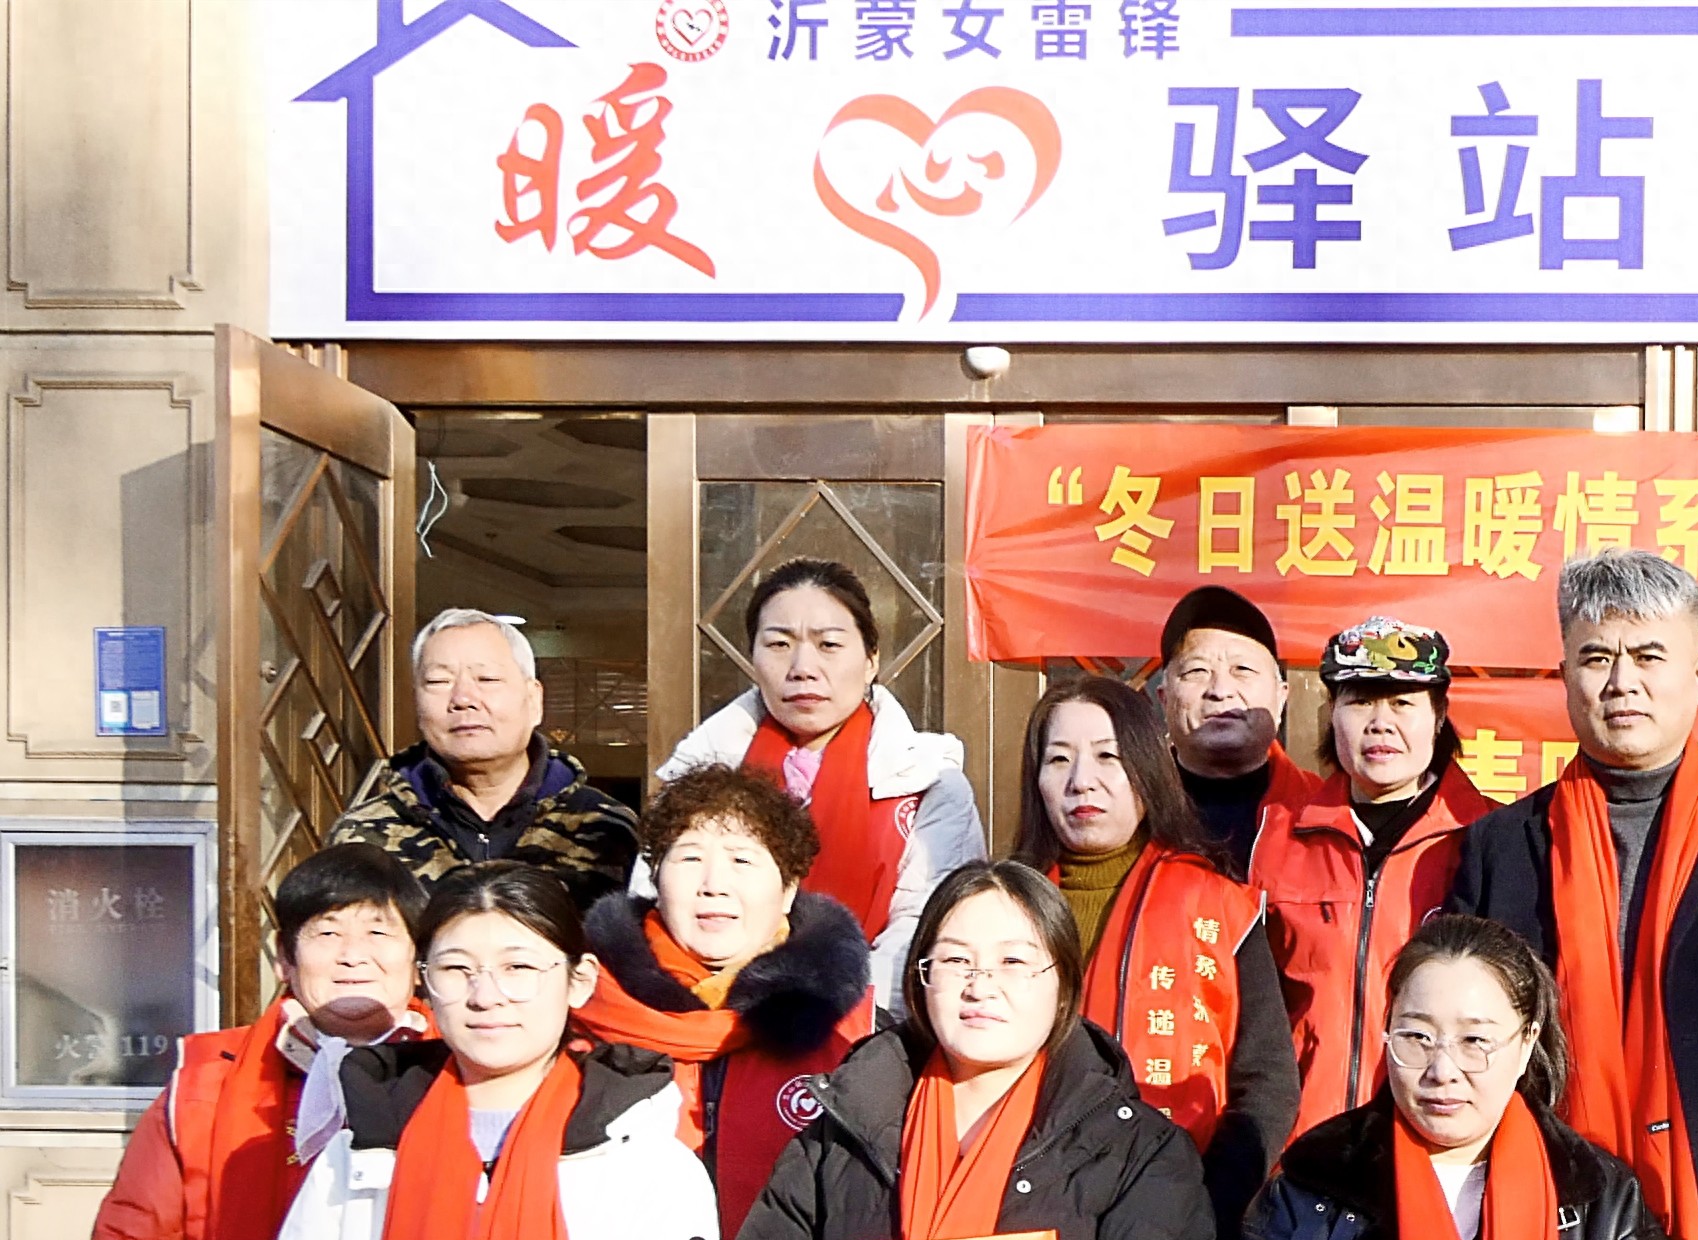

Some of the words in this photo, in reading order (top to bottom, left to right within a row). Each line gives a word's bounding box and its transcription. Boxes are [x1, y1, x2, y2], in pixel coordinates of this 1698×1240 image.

[767, 0, 1180, 61] 沂蒙女雷锋
[48, 887, 164, 921] 消火栓
[121, 1034, 168, 1056] 119
